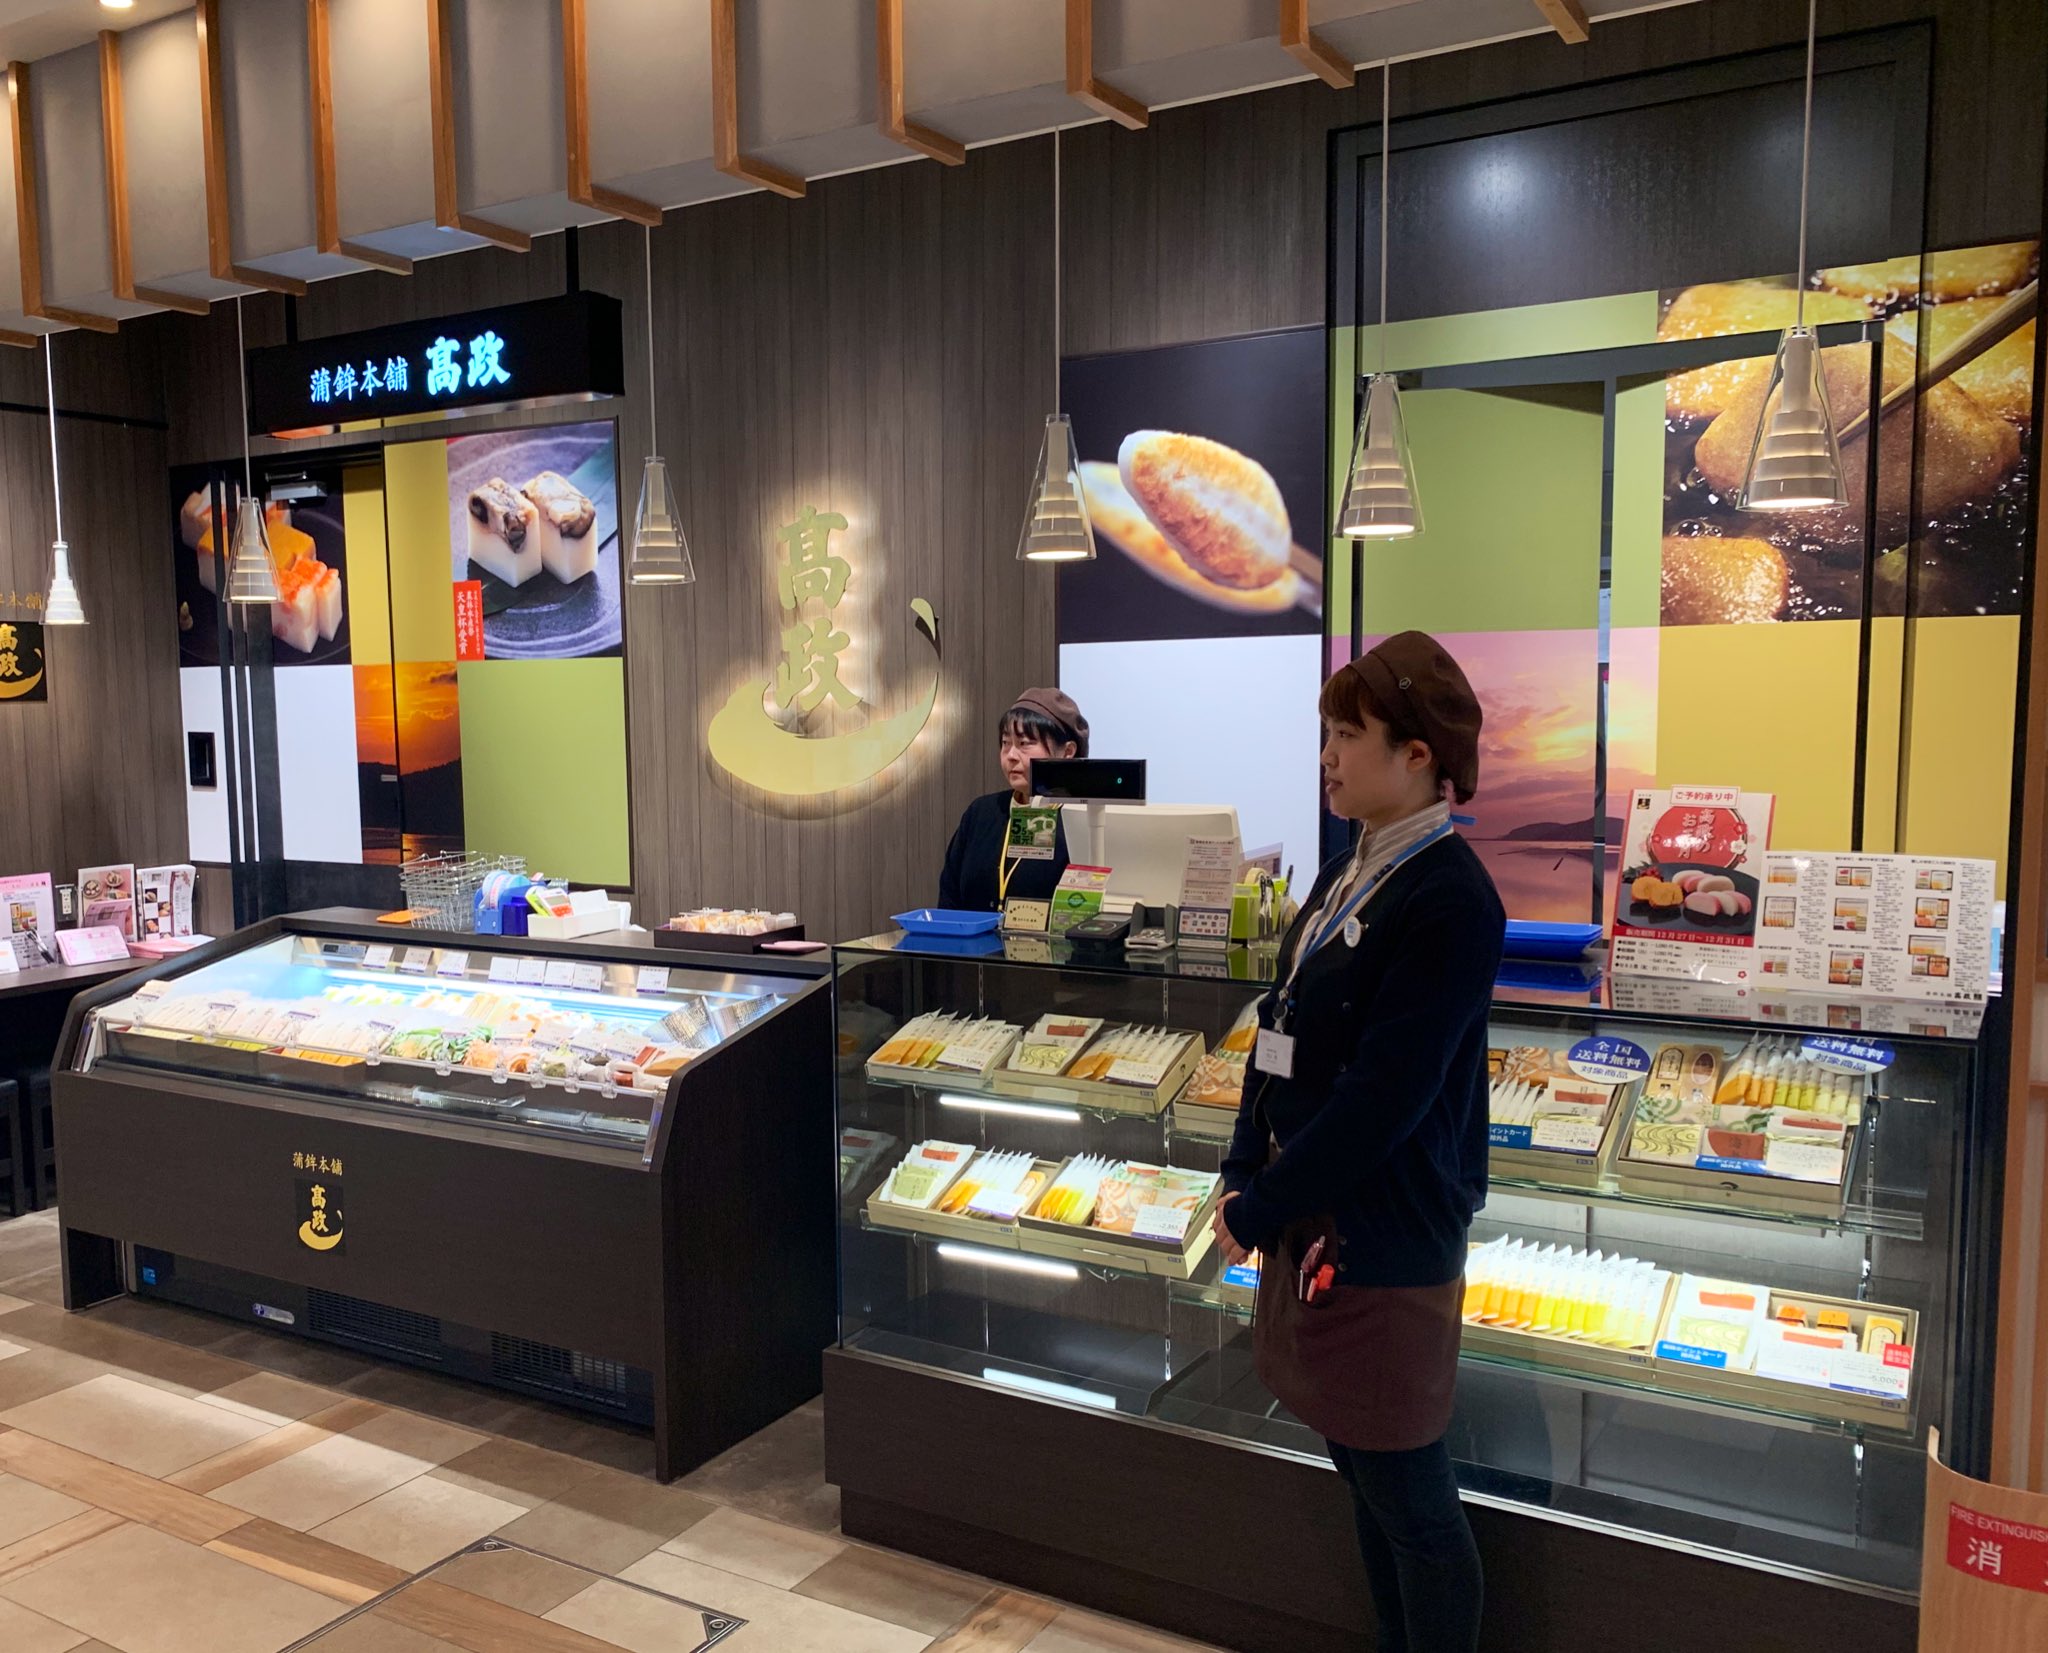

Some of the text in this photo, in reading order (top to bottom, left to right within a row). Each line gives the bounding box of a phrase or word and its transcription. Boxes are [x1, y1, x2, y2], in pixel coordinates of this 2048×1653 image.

[309, 355, 410, 403] 蒲鉾本舗
[1116, 777, 1123, 785] 0
[1675, 791, 1734, 801] ご予約承り中
[1595, 1041, 1632, 1055] 全国
[1811, 1037, 1885, 1061] 送料無料
[1575, 1049, 1642, 1069] 送料無料
[1815, 1053, 1867, 1073] 対象商品
[1581, 1065, 1628, 1080] 対象商品
[292, 1151, 343, 1176] 蒲鉾本舗
[1951, 1505, 1976, 1526] FIRE
